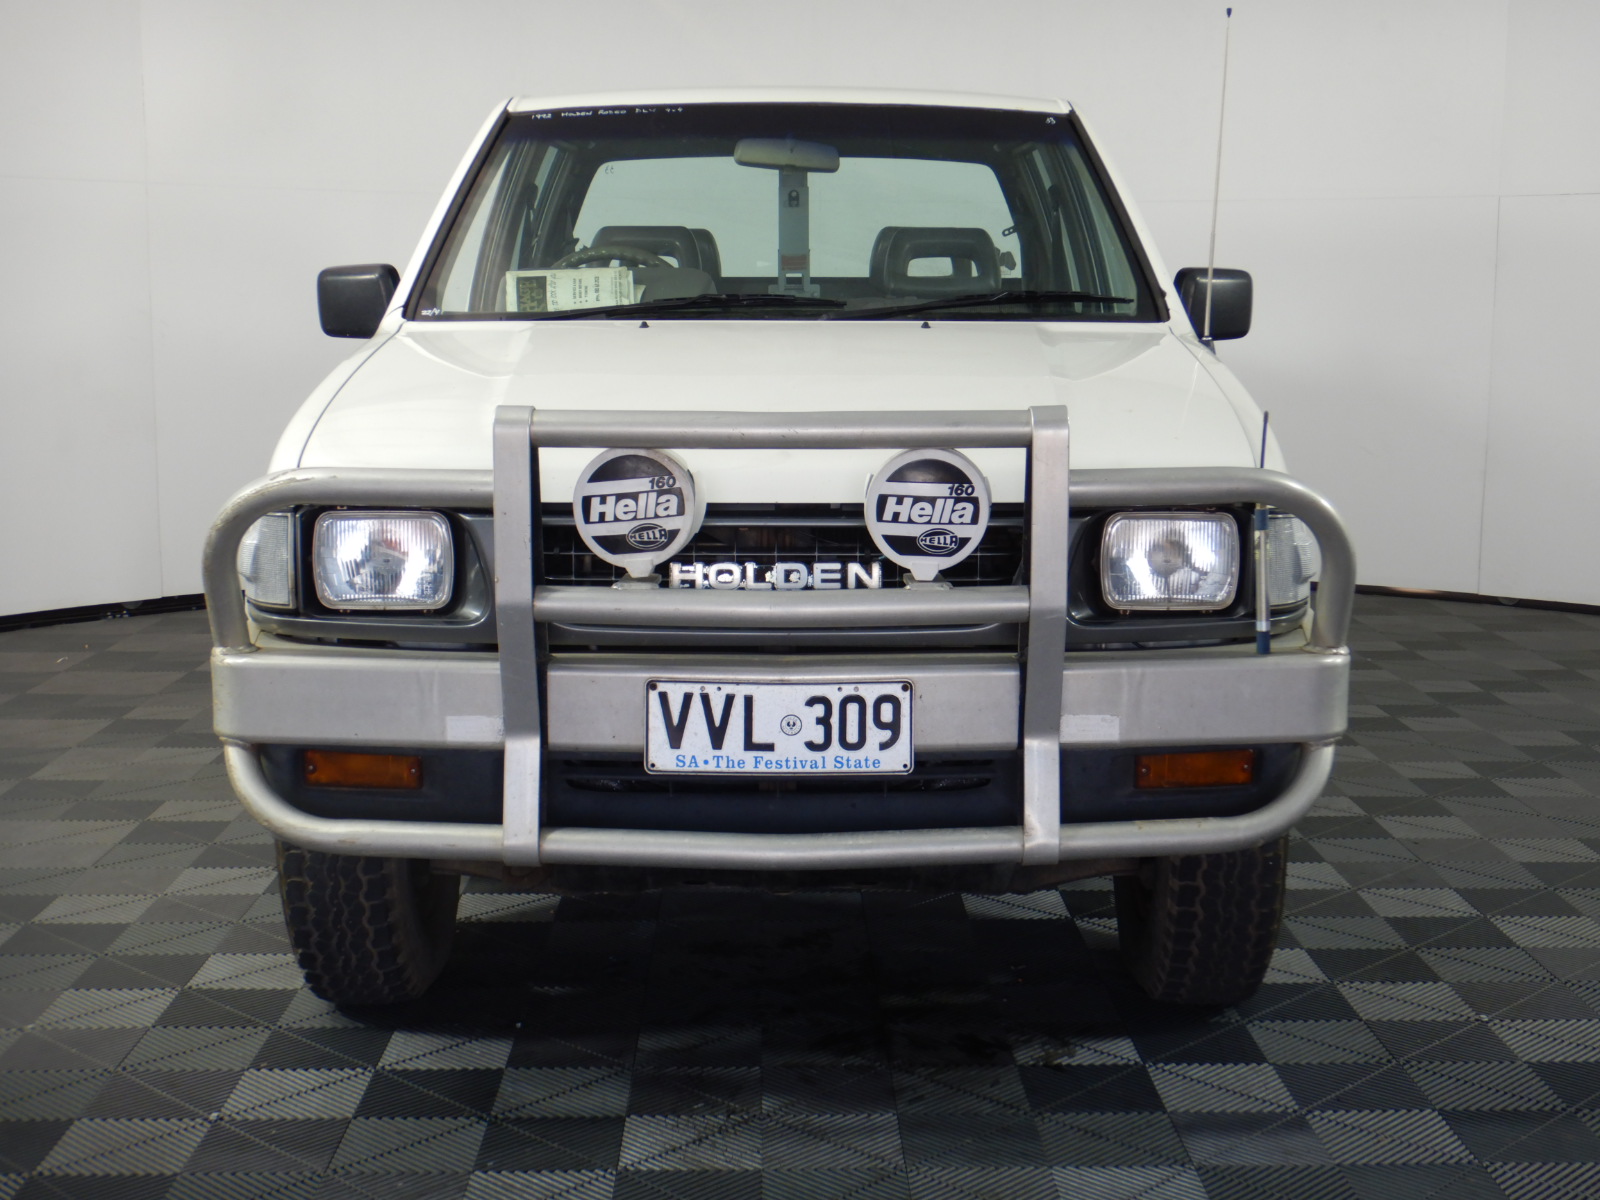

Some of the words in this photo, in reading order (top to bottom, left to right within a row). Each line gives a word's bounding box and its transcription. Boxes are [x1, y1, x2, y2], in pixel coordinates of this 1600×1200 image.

[649, 475, 677, 490] 160
[948, 484, 975, 497] 160
[589, 491, 679, 523] Hella
[882, 496, 975, 524] Hella
[629, 528, 668, 541] HELLA
[920, 535, 959, 547] HELLA
[669, 561, 883, 590] HOLDEN
[658, 691, 775, 752] VVL
[804, 694, 901, 752] 309
[752, 755, 827, 770] Festival
[833, 755, 882, 769] State
